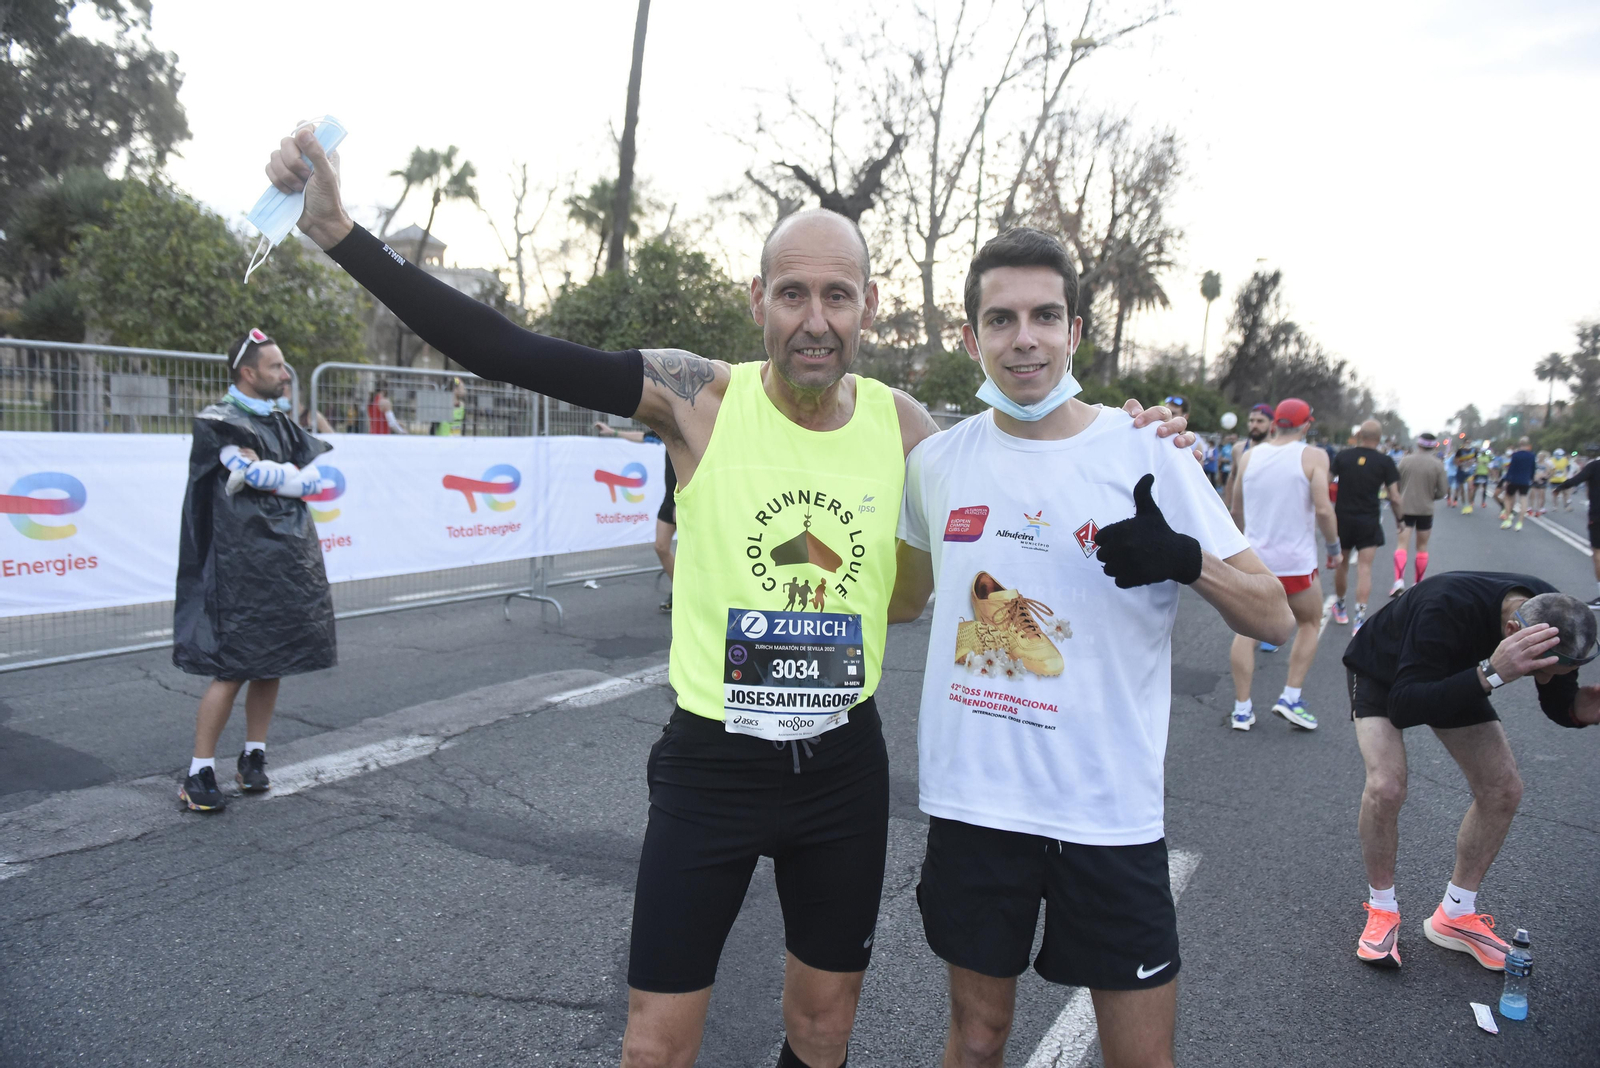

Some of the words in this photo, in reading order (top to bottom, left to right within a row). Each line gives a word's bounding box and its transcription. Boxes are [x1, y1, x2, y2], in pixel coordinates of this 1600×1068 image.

[755, 489, 854, 526] RUNNERS
[858, 504, 876, 514] ipso
[595, 512, 650, 526] TotalEnergies
[445, 522, 522, 539] TotalEnergies
[995, 529, 1034, 541] Albufeira
[0, 553, 98, 579] Energies
[746, 533, 777, 591] COOL
[772, 619, 847, 636] ZURICH
[772, 659, 819, 680] 3034
[727, 690, 858, 708] JOSESANTIAGO66
[949, 692, 962, 704] DAS
[962, 696, 1019, 715] MENDOEIRAS
[983, 689, 1059, 713] INTERNACIONAL
[1022, 720, 1044, 729] COUNTRY
